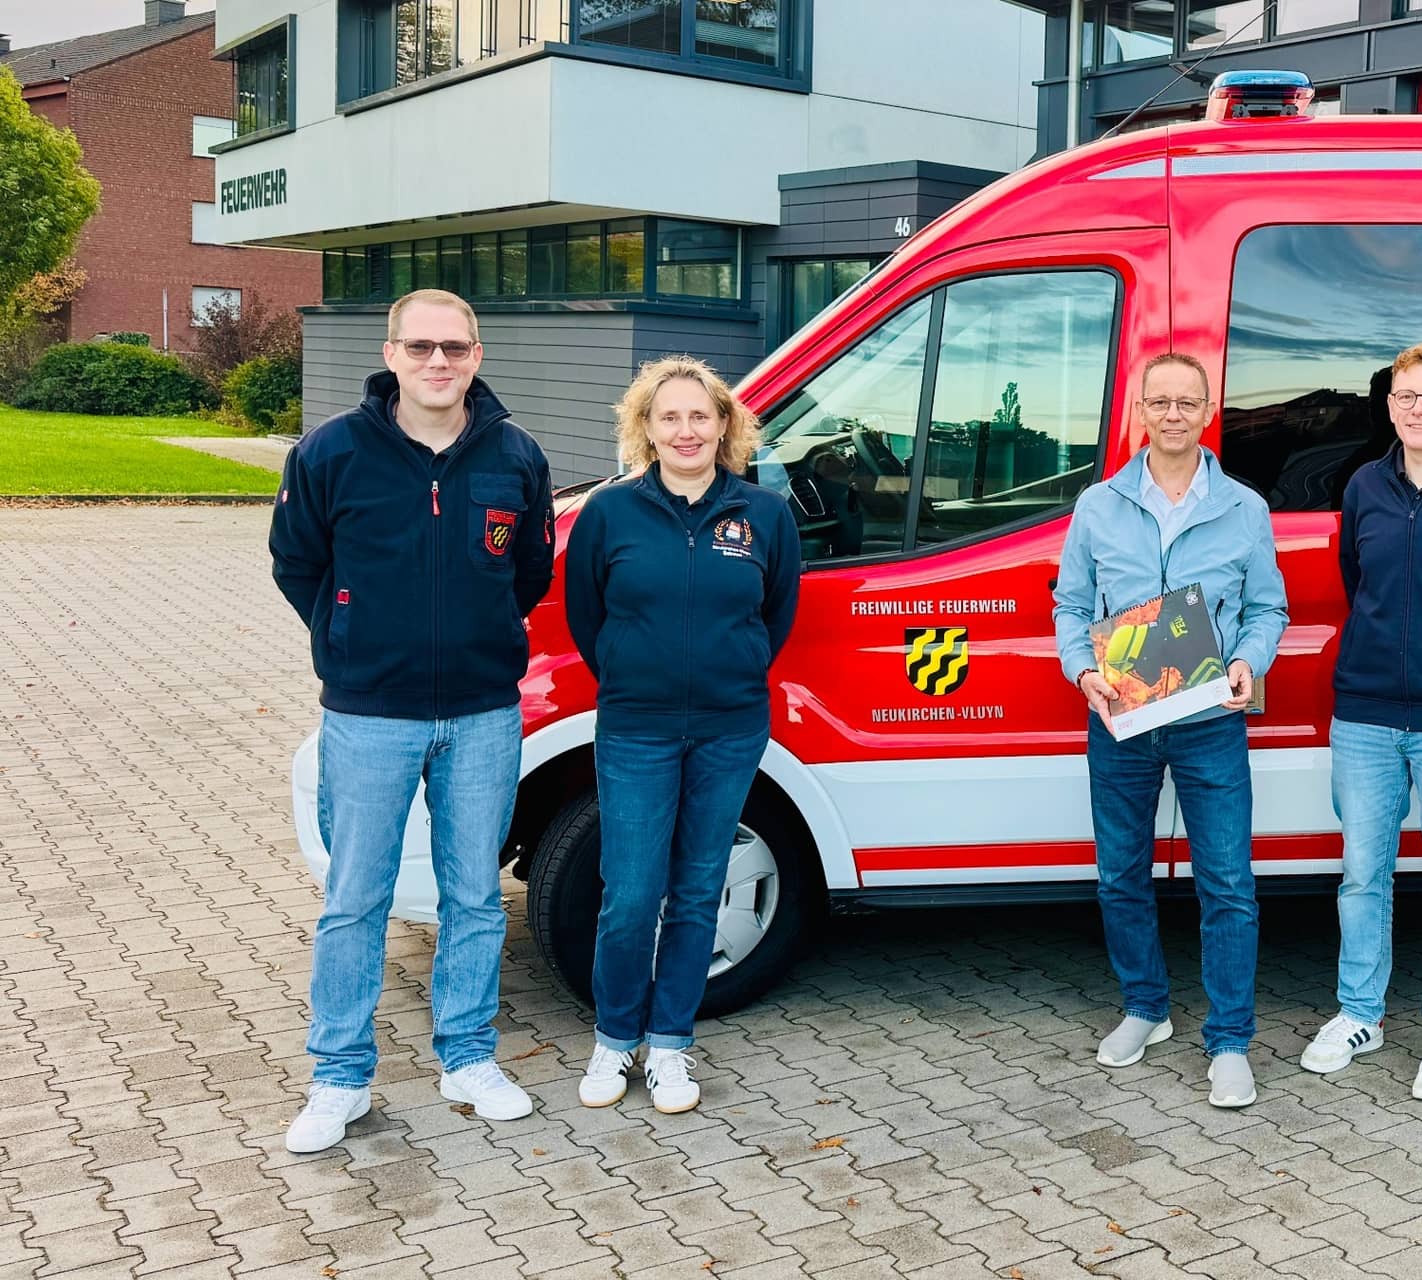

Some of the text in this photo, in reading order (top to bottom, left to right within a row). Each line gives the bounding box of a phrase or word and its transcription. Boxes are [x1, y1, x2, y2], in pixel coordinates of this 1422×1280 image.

[221, 168, 287, 215] FEUERWEHR
[894, 216, 911, 237] 46
[851, 599, 1017, 616] FREIWILLIGE FEUERWEHR
[871, 706, 1004, 722] NEUKIRCHEN-VLUYN
